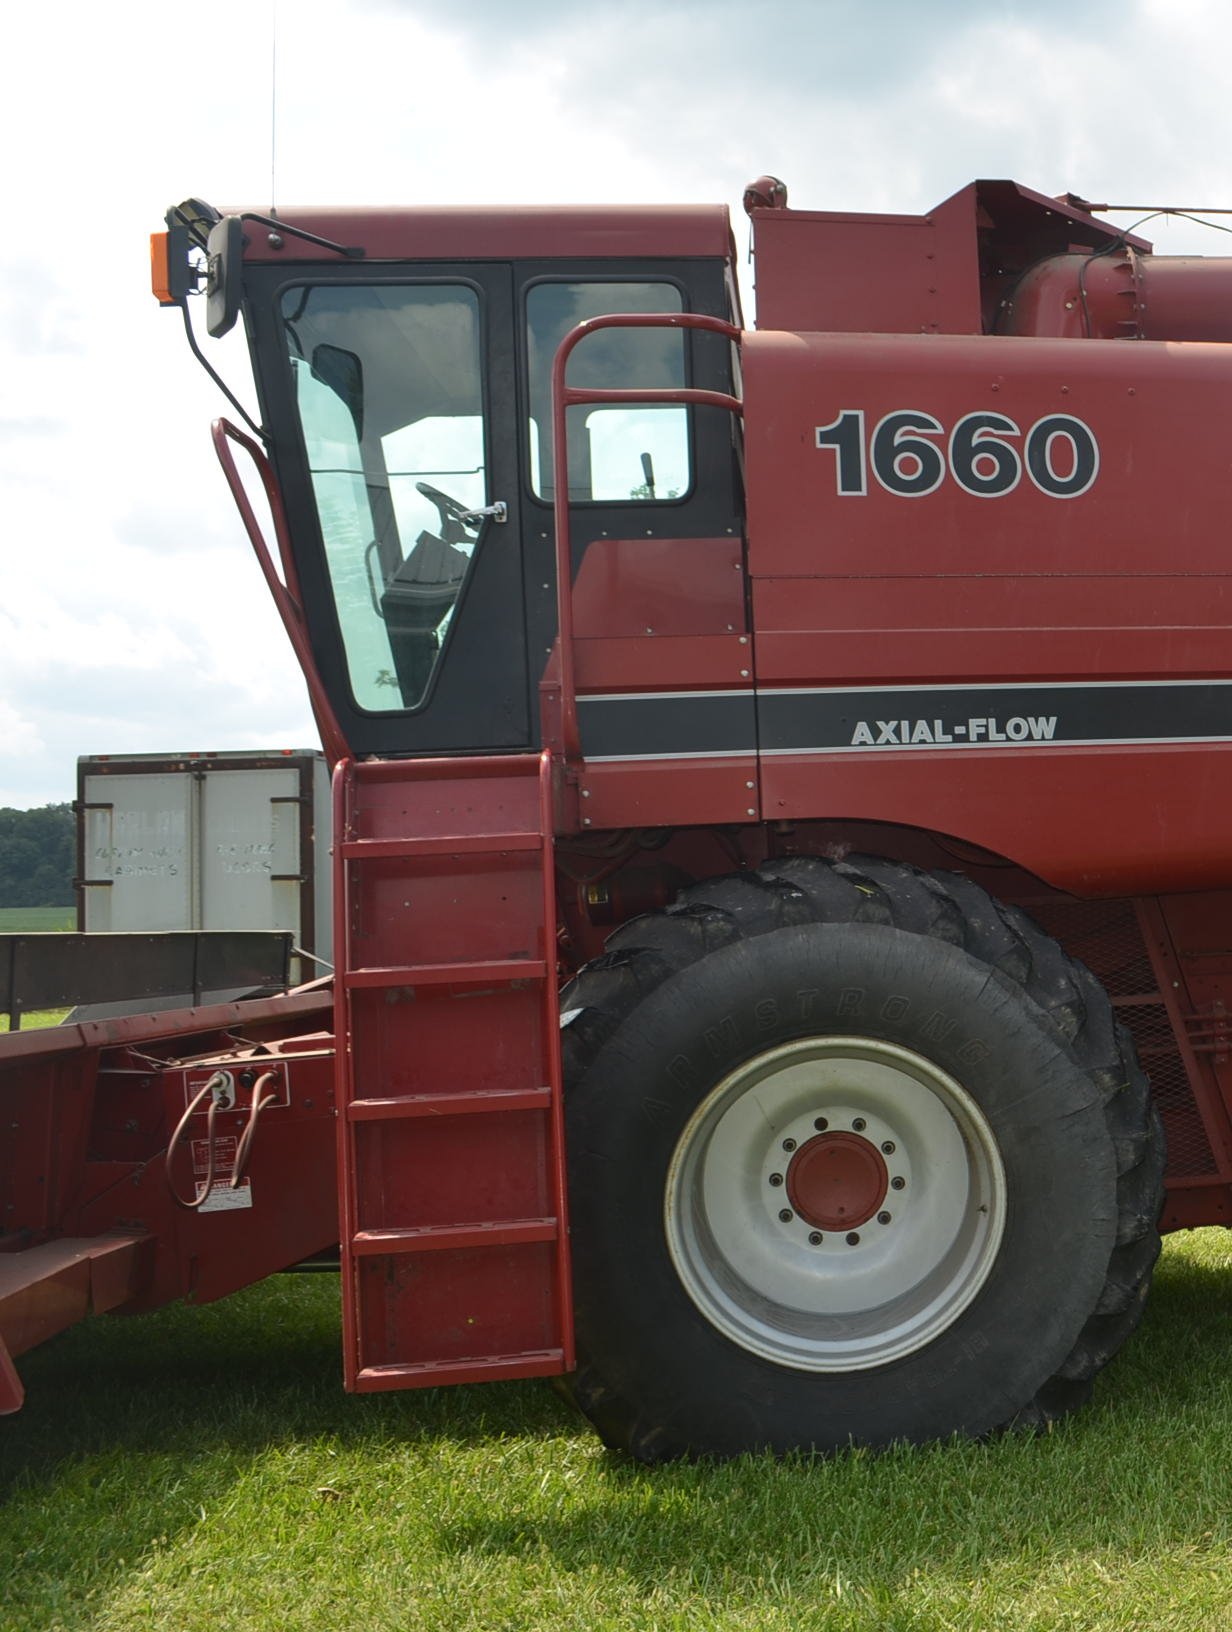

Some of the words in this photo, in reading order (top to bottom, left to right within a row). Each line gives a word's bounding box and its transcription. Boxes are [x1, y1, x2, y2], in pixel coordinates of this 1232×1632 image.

[815, 409, 1100, 499] 1660
[851, 716, 1058, 745] AXIAL-FLOW
[640, 987, 992, 1127] ARMSTRONG
